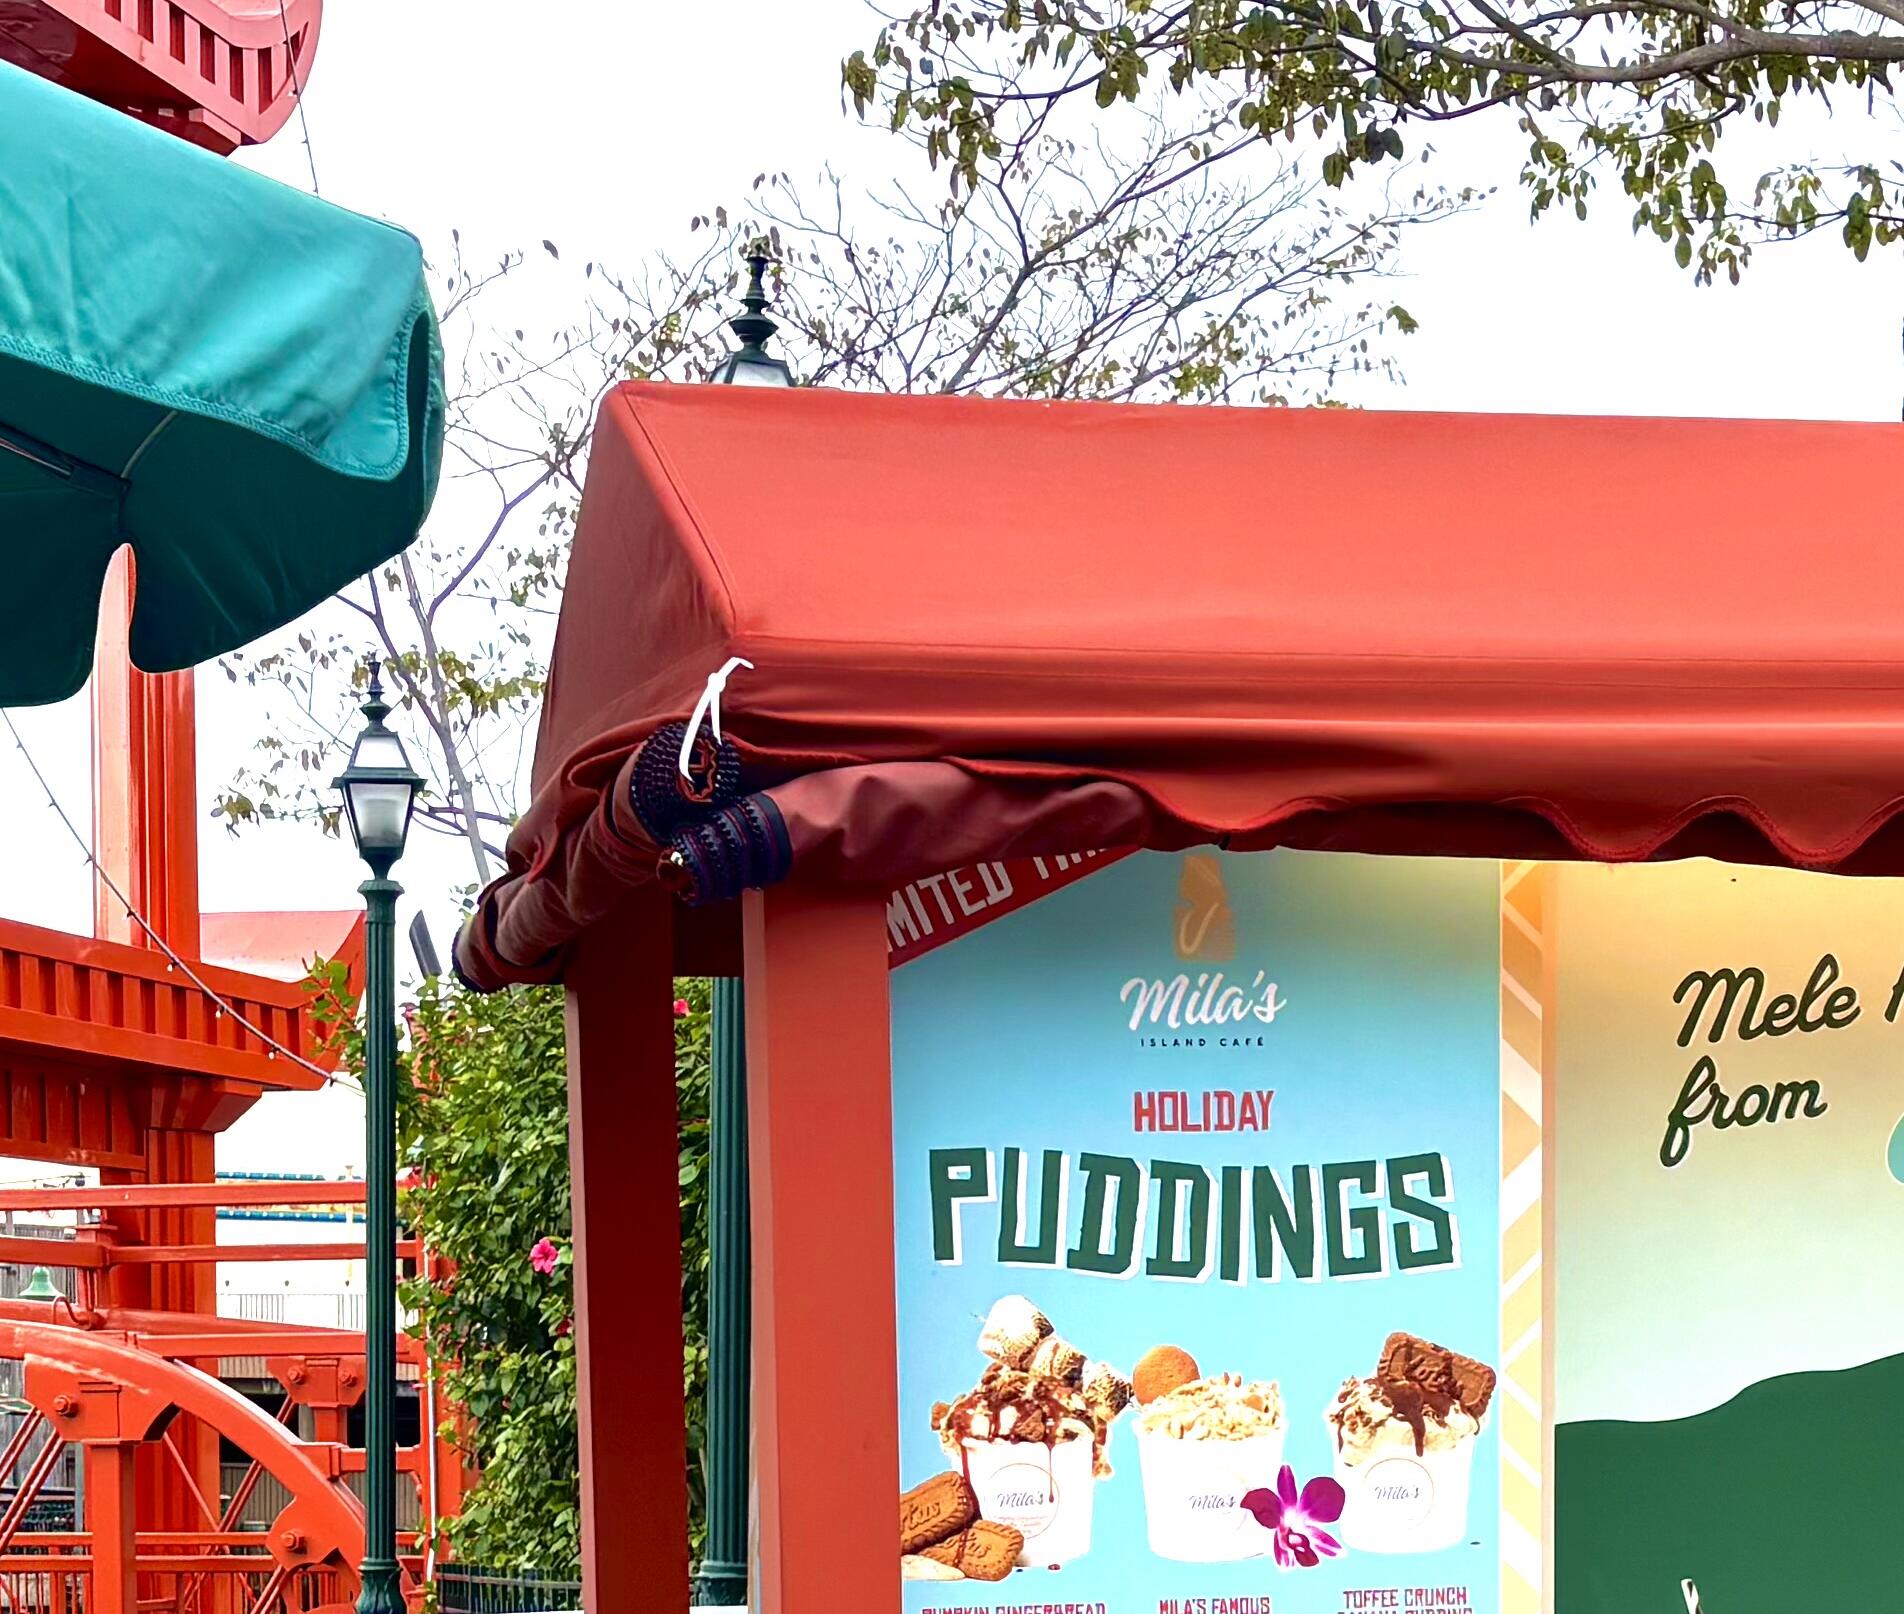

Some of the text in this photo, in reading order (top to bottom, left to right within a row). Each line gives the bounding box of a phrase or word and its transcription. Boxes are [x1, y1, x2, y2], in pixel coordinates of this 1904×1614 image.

[886, 862, 1014, 953] MITED
[1120, 970, 1287, 1031] Mila's
[1672, 952, 1863, 1048] Mele
[1140, 1034, 1265, 1047] ISLAND CAFÉ
[1133, 1089, 1274, 1132] HOLIDAY
[1660, 1056, 1827, 1168] from
[929, 1147, 1458, 1284] PUDDINGS
[997, 1491, 1044, 1508] Mila's
[1189, 1494, 1236, 1509] Mila's
[1375, 1486, 1421, 1500] Mila's
[1343, 1586, 1468, 1609] TOFFEE CRUNCH
